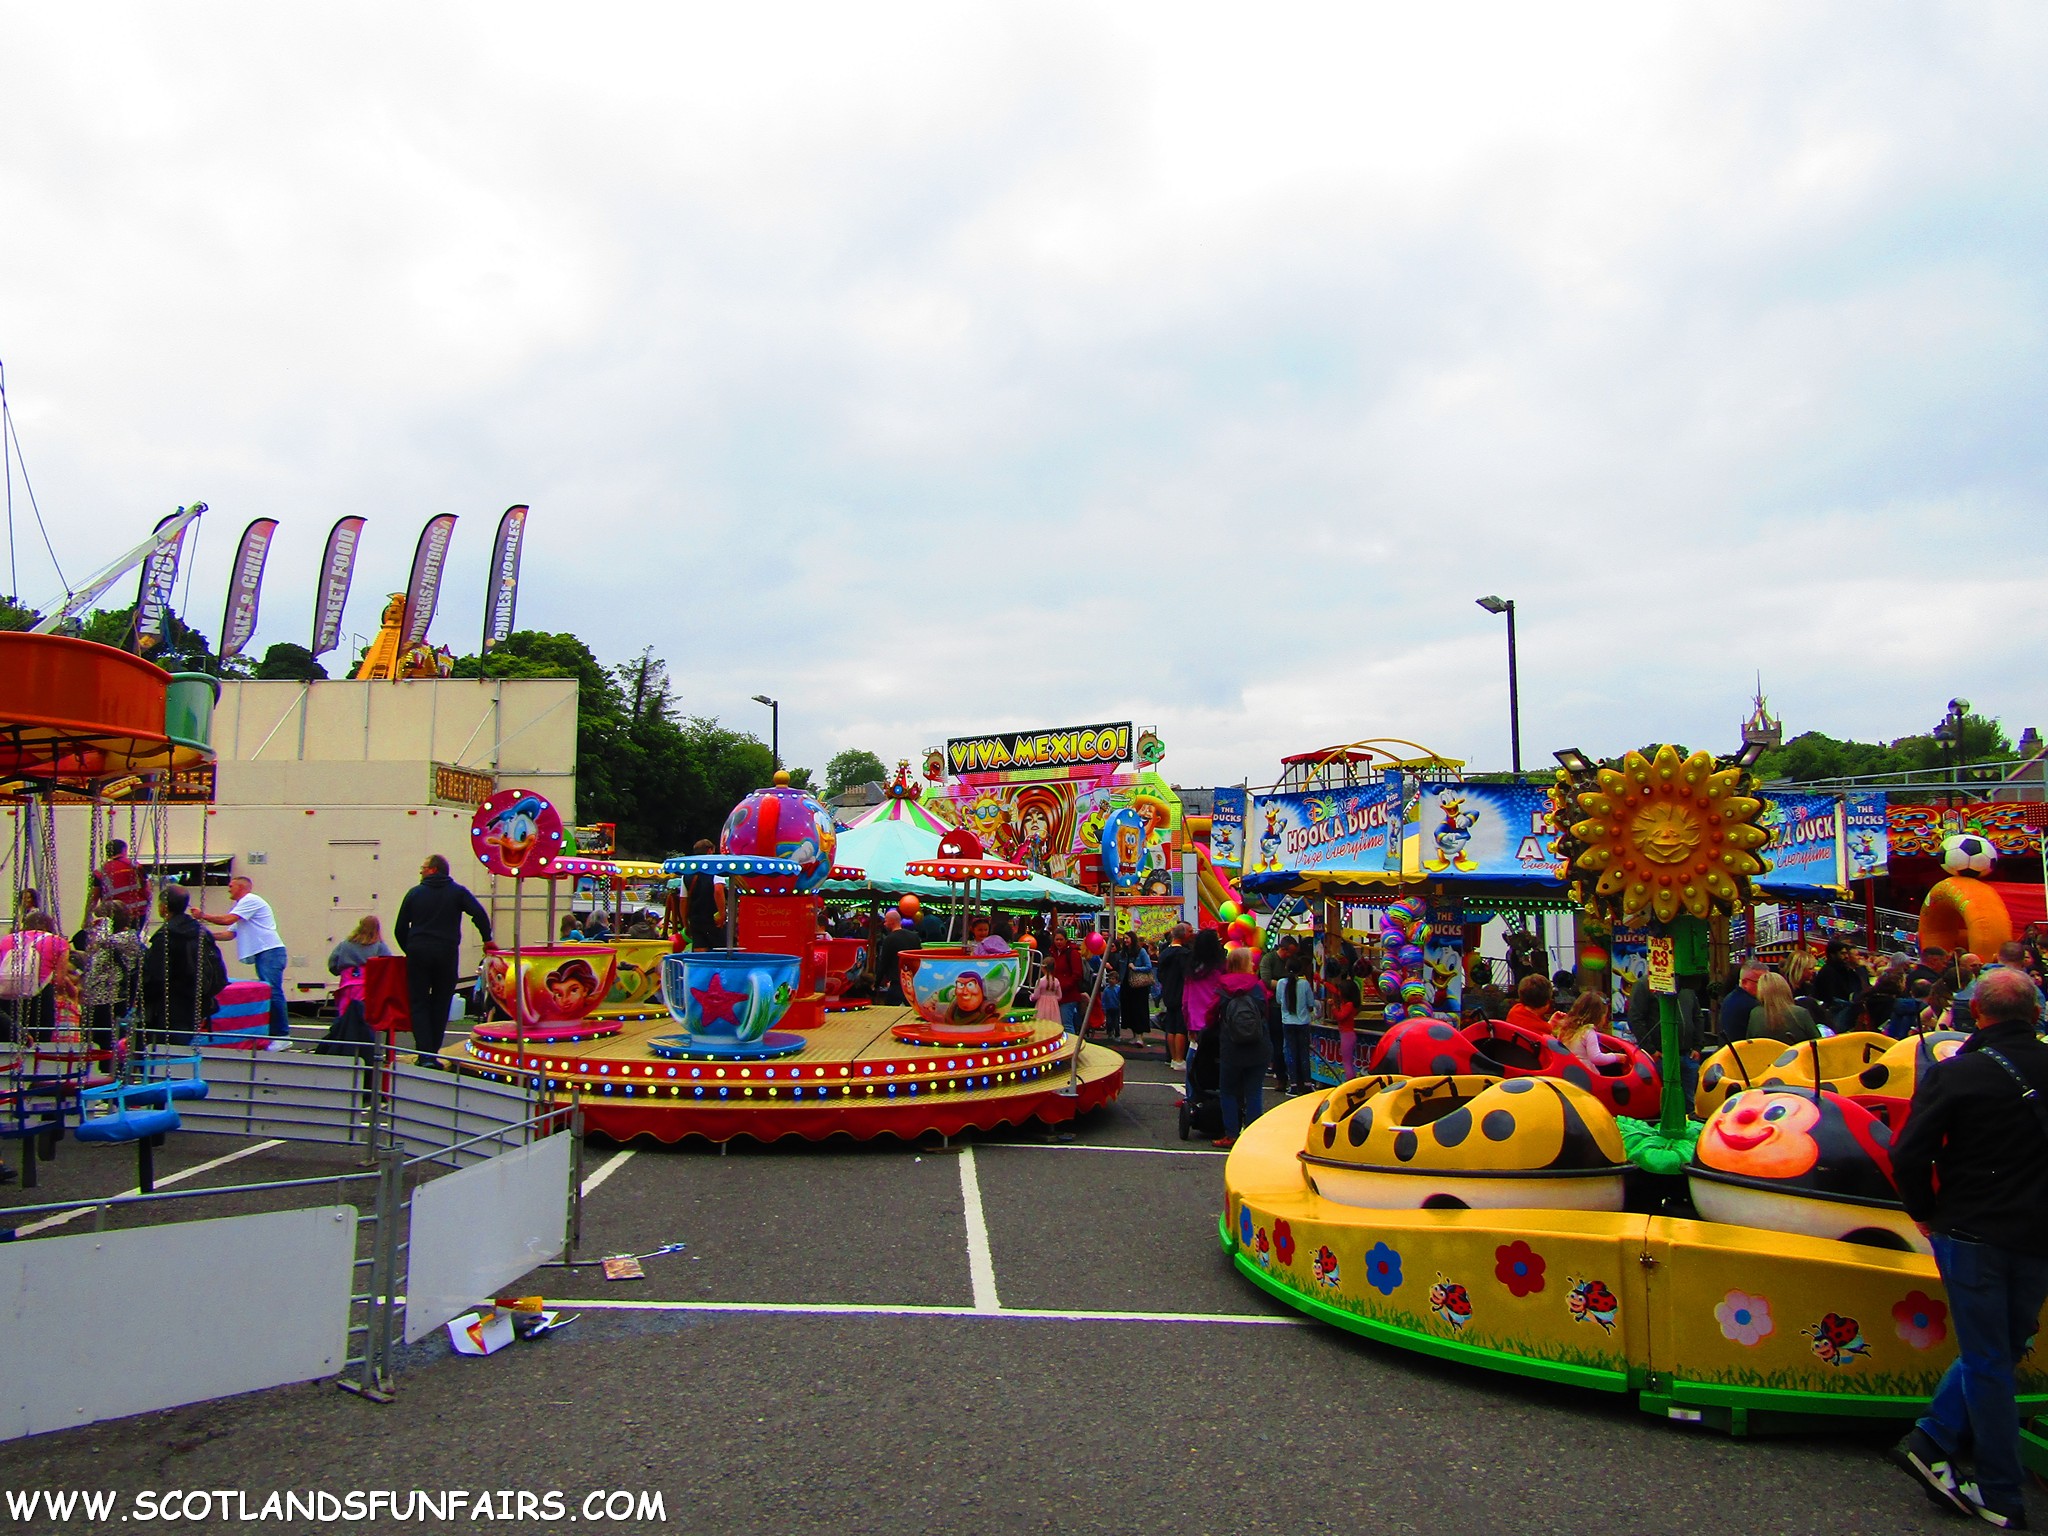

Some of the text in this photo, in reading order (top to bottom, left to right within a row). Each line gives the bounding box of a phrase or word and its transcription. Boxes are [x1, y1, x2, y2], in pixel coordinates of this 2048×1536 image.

[241, 533, 268, 589] CHILLI
[502, 518, 521, 580] NOODLES
[139, 542, 179, 635] NACHOS
[319, 528, 357, 646] STREET FOOD
[408, 526, 448, 644] BURGERS/HOTDOGS
[231, 607, 253, 648] SALT
[949, 726, 1130, 772] VIVA MEXICO!
[436, 767, 470, 803] STREET
[1213, 814, 1242, 823] DUCKS
[1221, 806, 1235, 814] THE
[1847, 815, 1884, 825] DUCKS
[1856, 805, 1874, 813] THE
[1287, 801, 1388, 854] HOOK A DUCK
[1783, 822, 1794, 847] A
[1795, 814, 1836, 844] DUCK
[1325, 830, 1385, 861] Everytime
[1515, 836, 1545, 861] A
[1777, 844, 1831, 871] Everytime
[1522, 857, 1564, 873] Every
[1436, 911, 1453, 921] THE
[1652, 950, 1669, 967] £3
